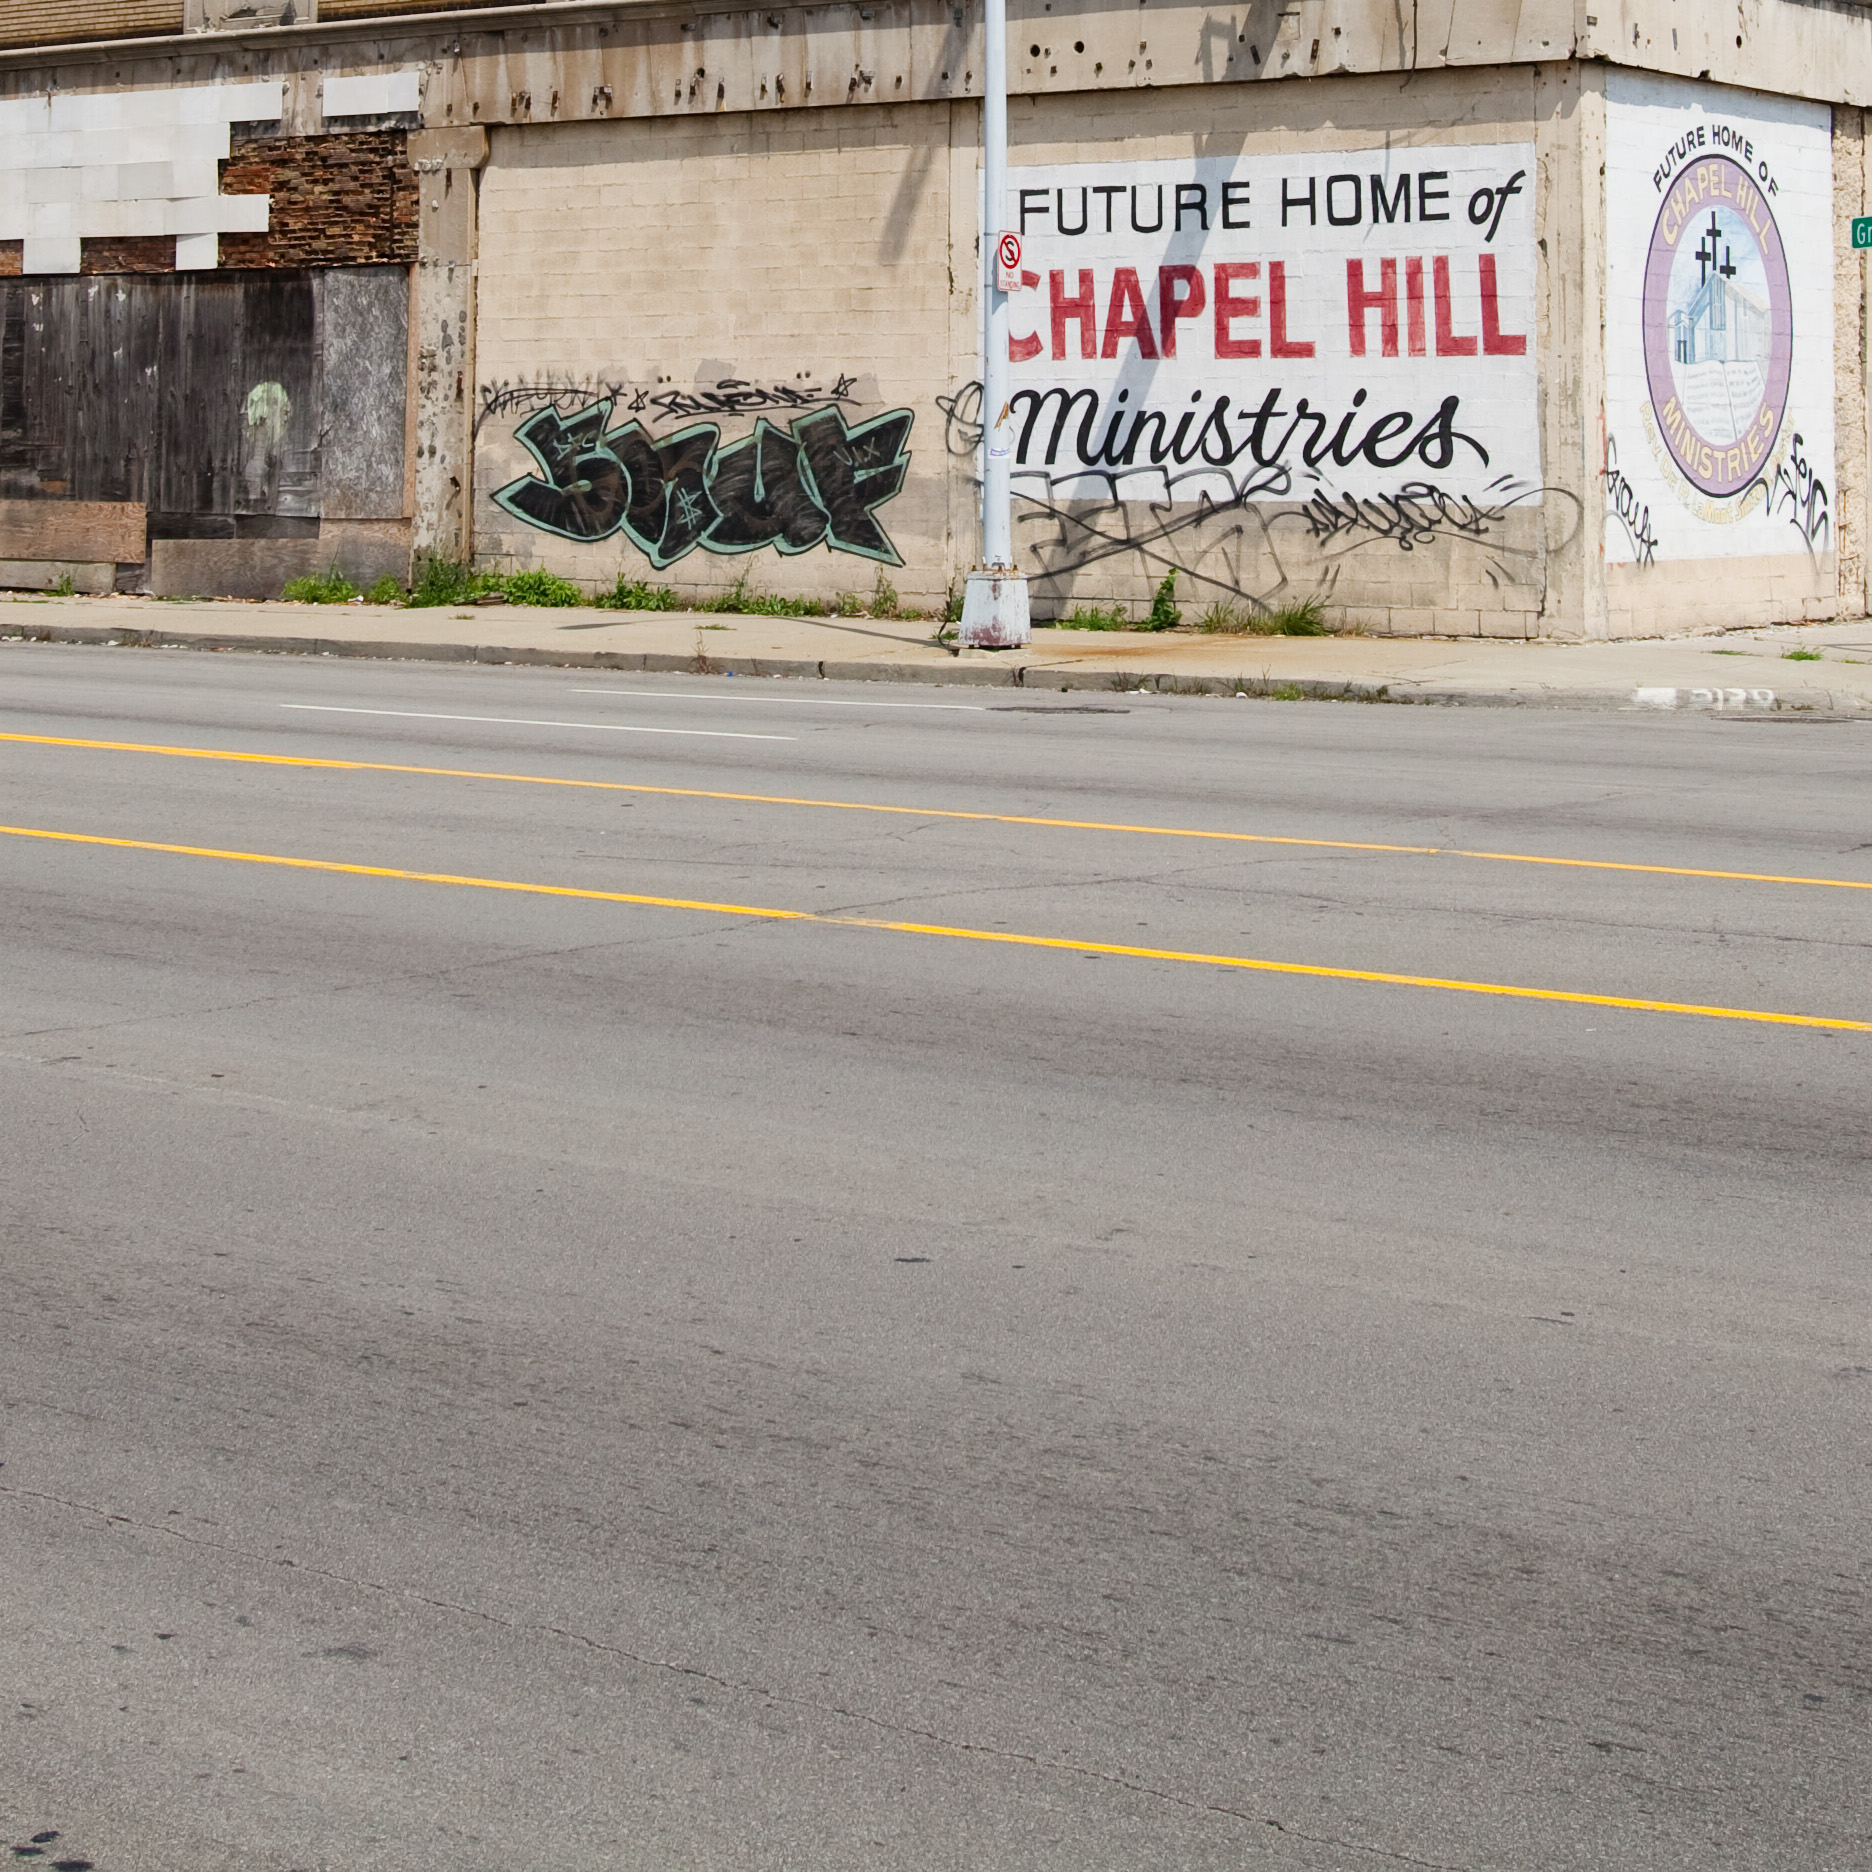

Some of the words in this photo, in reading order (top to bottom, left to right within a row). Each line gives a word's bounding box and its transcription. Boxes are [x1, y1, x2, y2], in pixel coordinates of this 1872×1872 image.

[1653, 126, 1706, 193] FUTURE
[1712, 124, 1754, 162] HOME
[1758, 161, 1779, 196] OF
[1018, 181, 1251, 236] FUTURE
[1281, 170, 1450, 227] HOME
[1467, 169, 1526, 242] of
[1662, 163, 1732, 246] CHAPEL
[1736, 175, 1771, 255] HILL
[1005, 271, 1015, 279] NO
[1009, 260, 1315, 362] CHAPEL
[1346, 253, 1527, 358] HILL
[1009, 387, 1489, 469] Ministries
[1662, 396, 1775, 483] MINISTRIES
